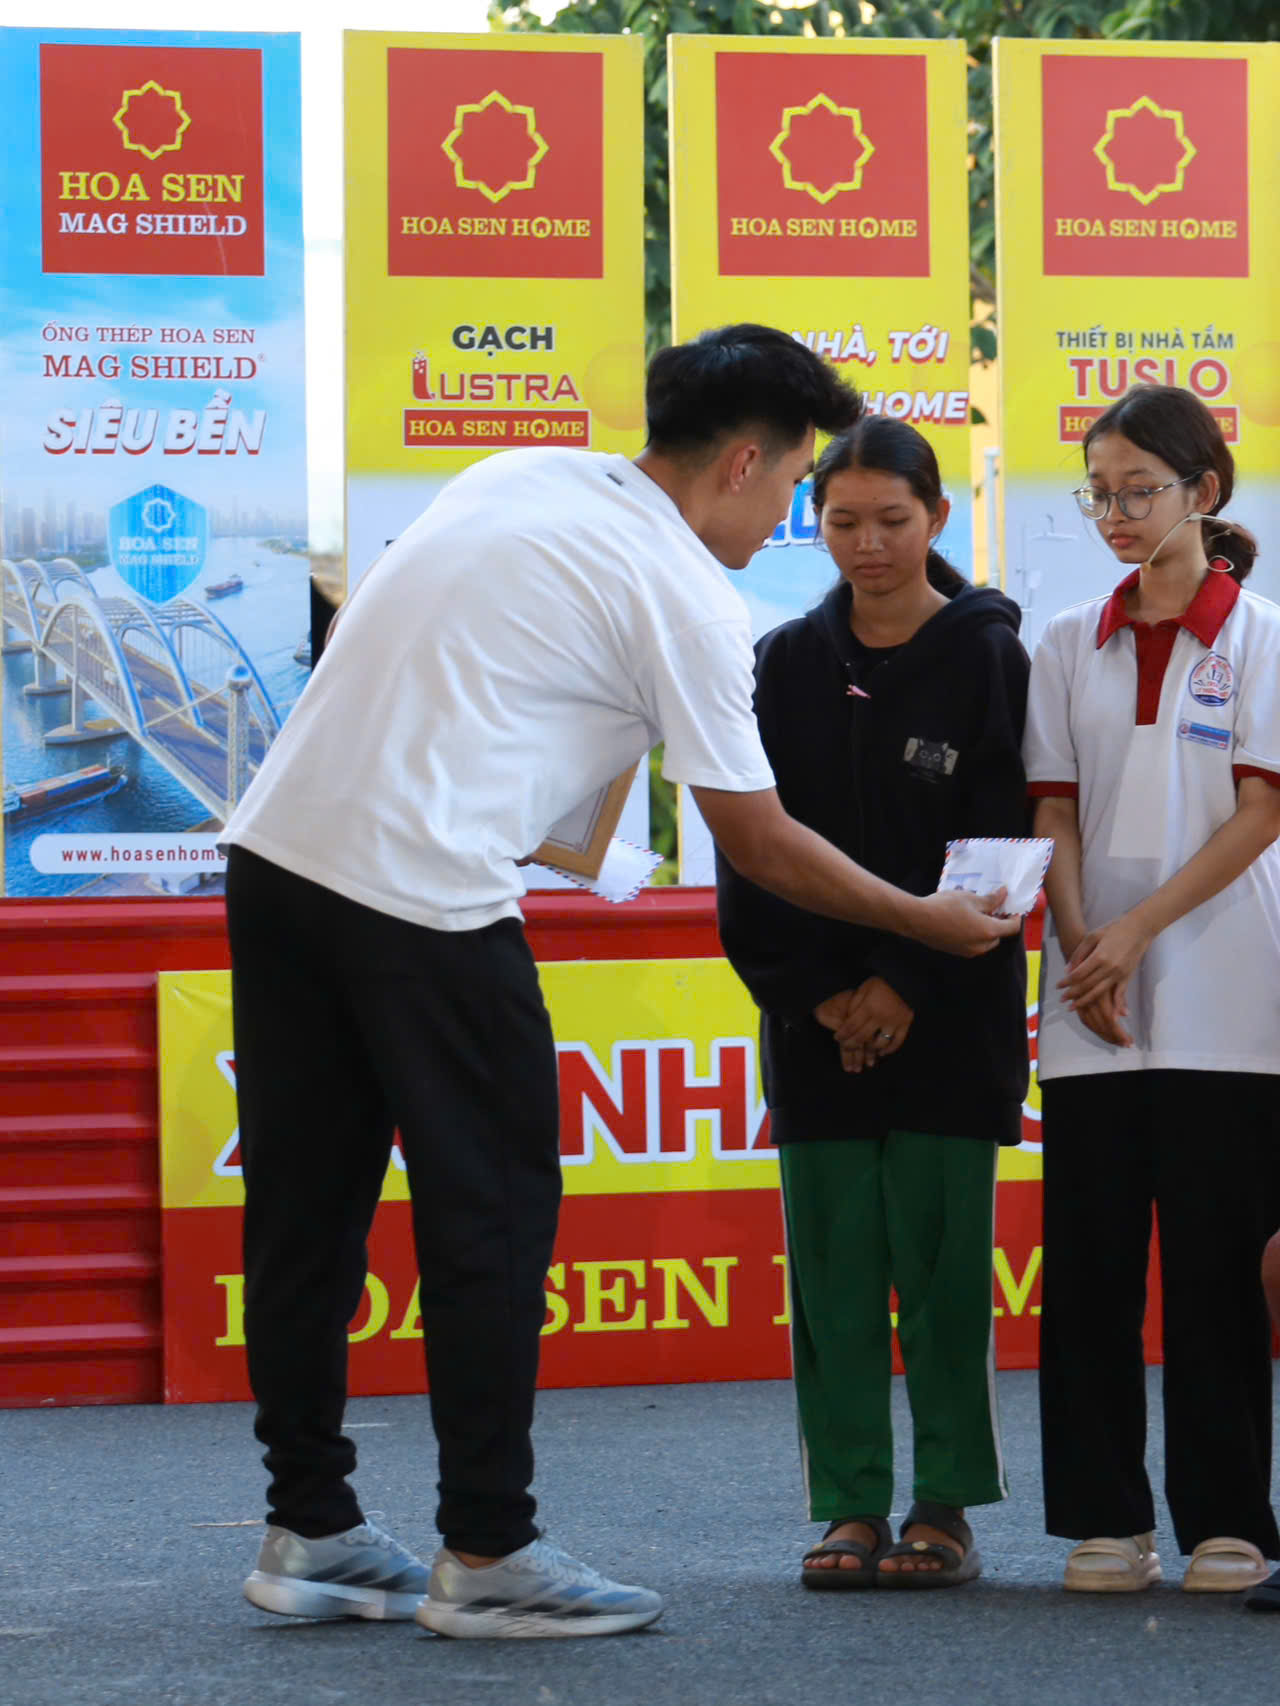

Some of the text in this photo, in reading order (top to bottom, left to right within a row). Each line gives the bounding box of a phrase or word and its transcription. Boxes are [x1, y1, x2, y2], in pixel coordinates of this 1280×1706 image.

[59, 171, 245, 203] HOA SEN
[59, 212, 247, 236] MAG SHIELD
[401, 216, 591, 238] HOA SEN HOME
[730, 217, 917, 238] HOA SEN HOME
[1056, 218, 1237, 240] HOA SEN HOME
[42, 321, 255, 344] ỐNG THÉP HOA SEN
[452, 325, 553, 358] GẠCH
[888, 325, 950, 363] TỚI
[1056, 324, 1108, 348] THIẾT
[1115, 332, 1134, 354] BỊ
[1140, 328, 1185, 349] NHÀ
[43, 355, 121, 378] MAG
[43, 387, 267, 455] SIÊU BỀN
[409, 418, 585, 439] HOA SEN HOME
[556, 1046, 779, 1157] NH
